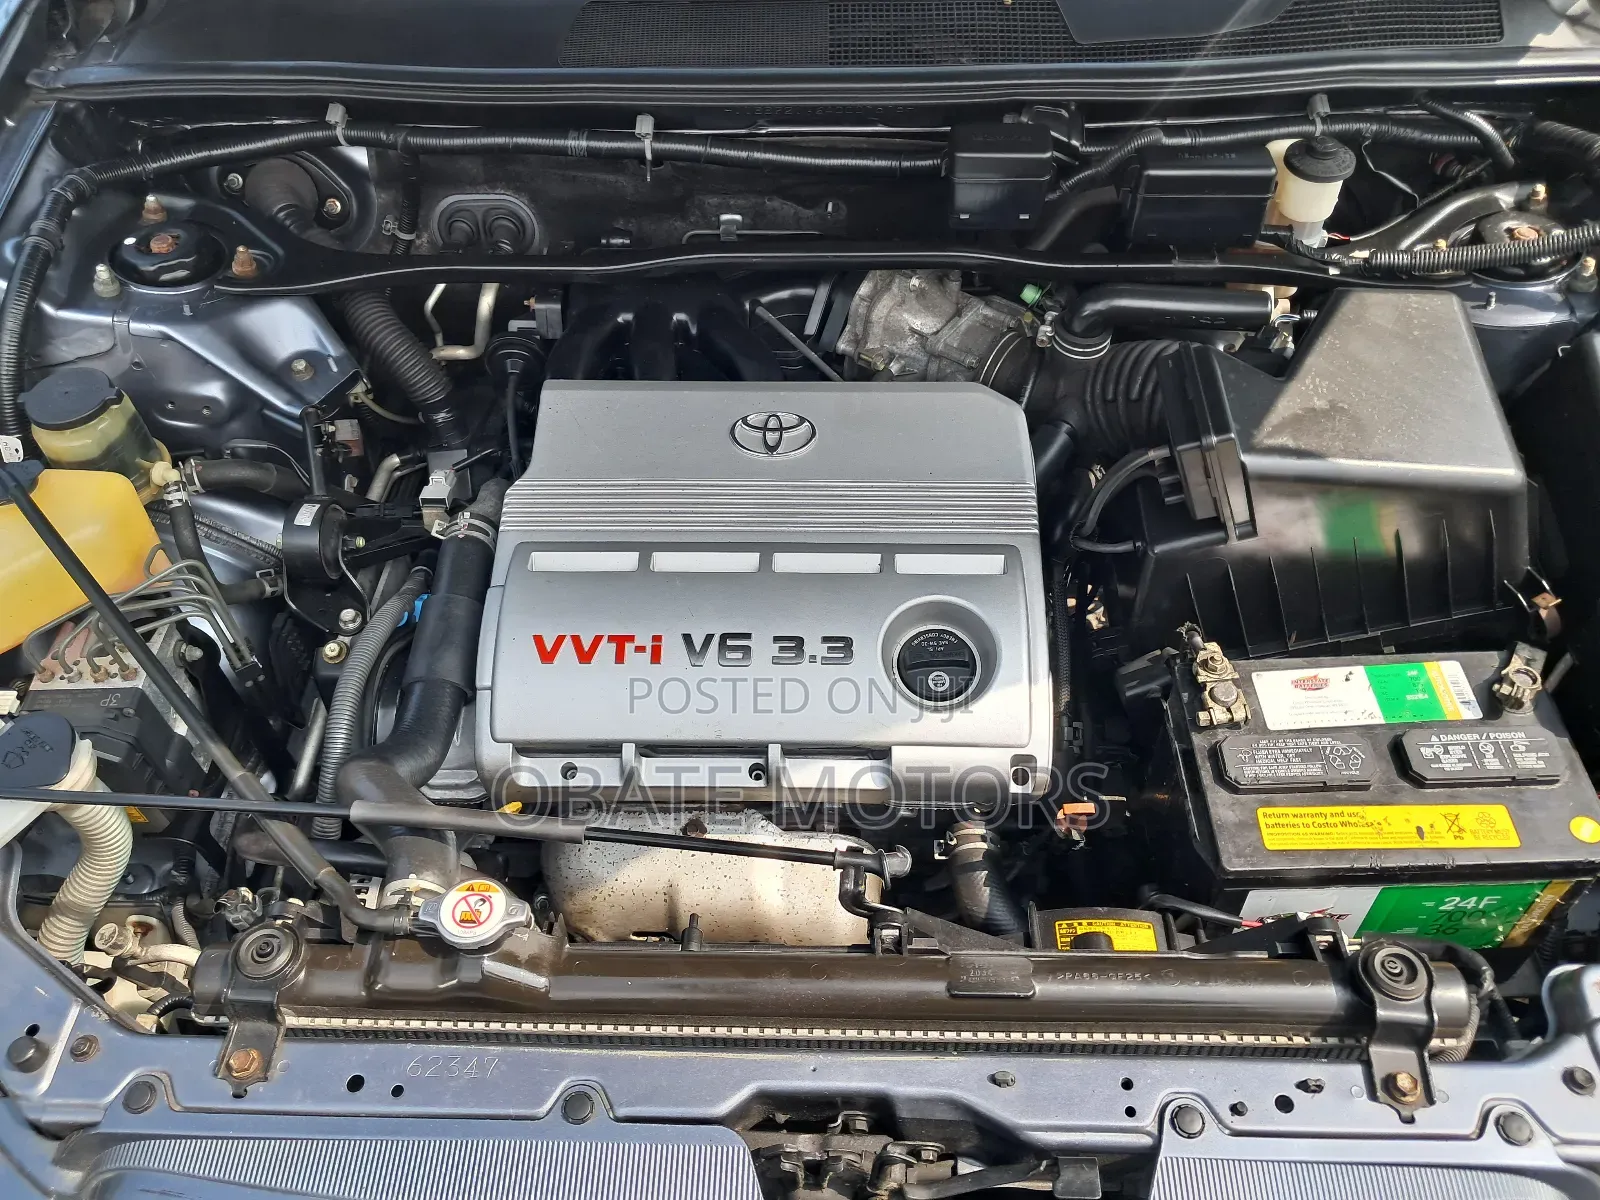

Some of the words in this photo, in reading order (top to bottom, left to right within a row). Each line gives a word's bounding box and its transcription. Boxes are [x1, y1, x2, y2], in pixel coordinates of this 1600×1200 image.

[532, 634, 663, 665] VVT-i
[681, 632, 753, 667] V6
[771, 635, 854, 666] 3.3
[1440, 732, 1481, 742] DANGER
[1490, 731, 1526, 740] POISON
[1263, 811, 1290, 819] Return
[1291, 811, 1328, 820] warranty
[1330, 810, 1345, 818] and
[1265, 821, 1301, 829] batteries
[1312, 820, 1338, 829] Costco
[1438, 896, 1502, 910] 24F
[1432, 910, 1487, 923] 700
[406, 1054, 499, 1079] 62347
